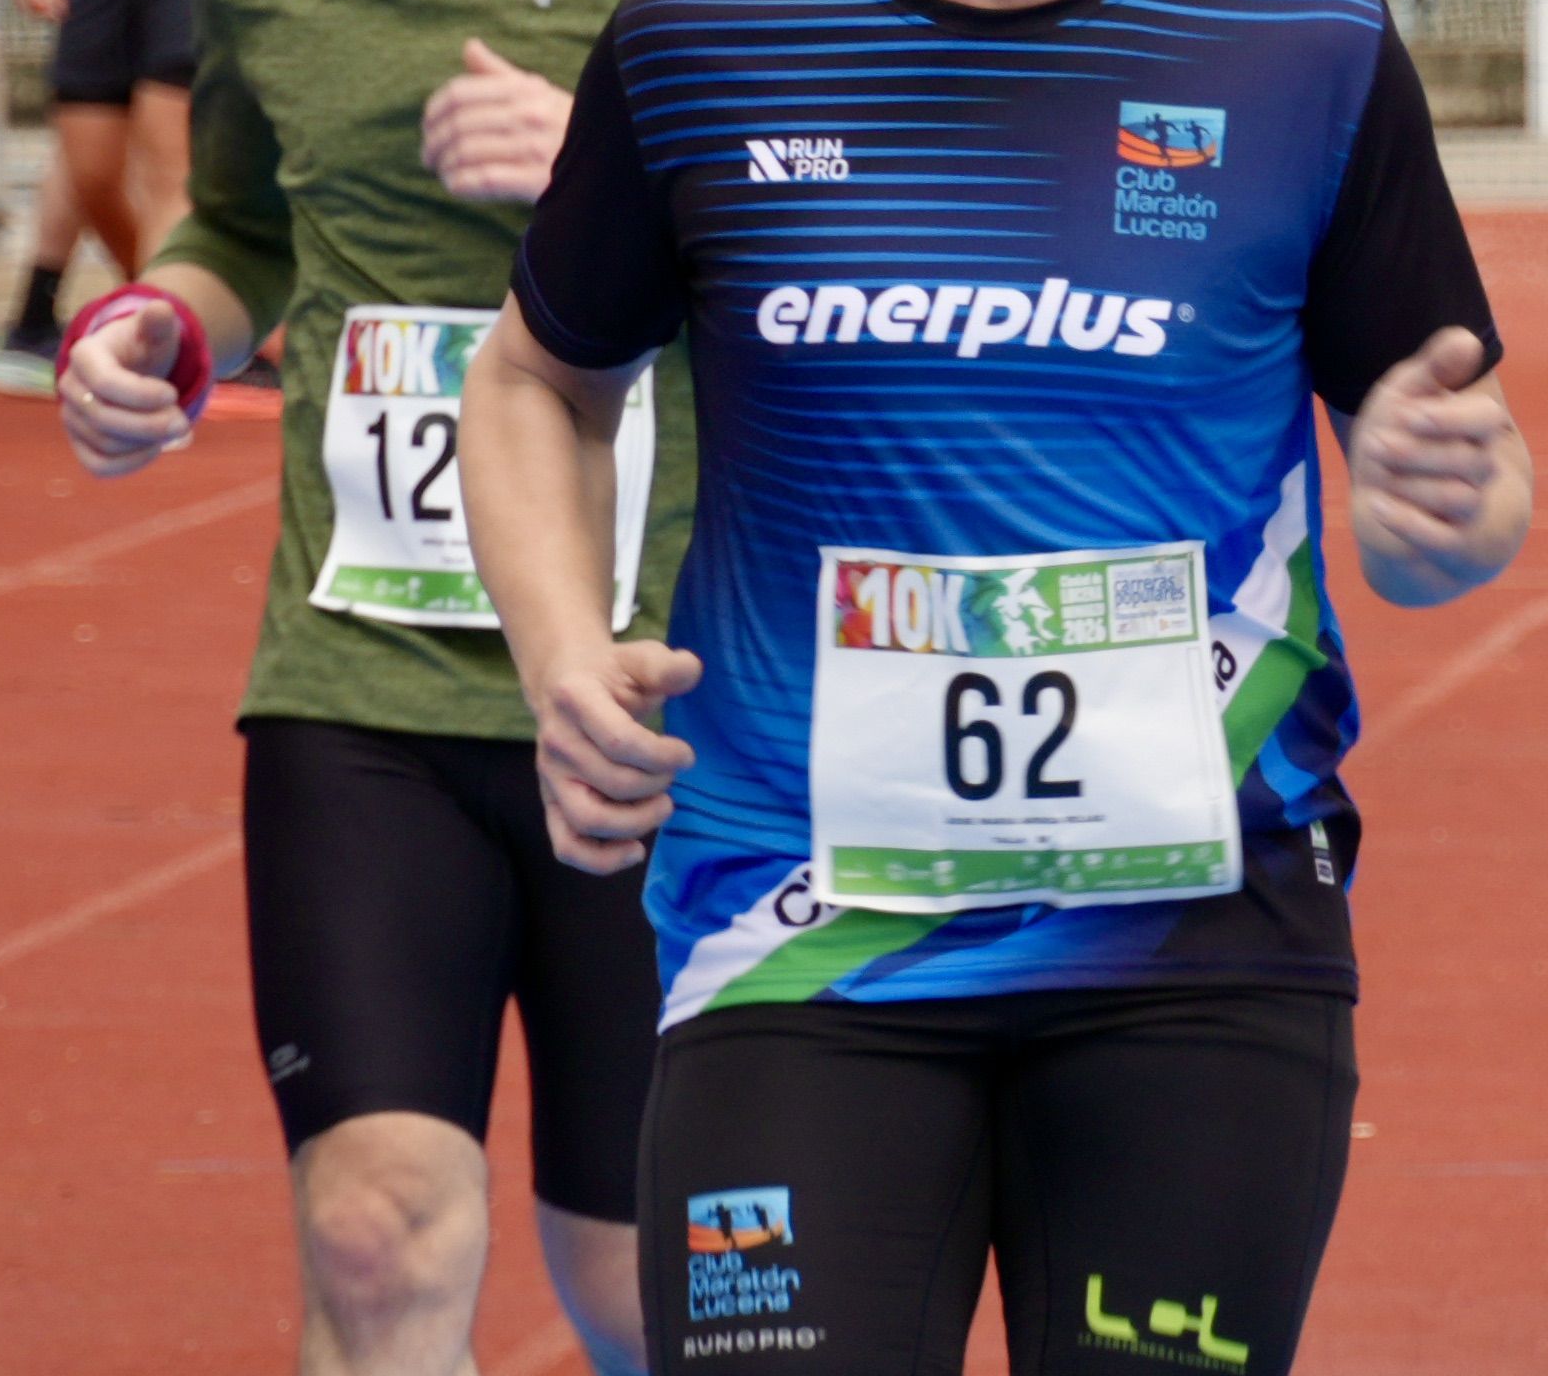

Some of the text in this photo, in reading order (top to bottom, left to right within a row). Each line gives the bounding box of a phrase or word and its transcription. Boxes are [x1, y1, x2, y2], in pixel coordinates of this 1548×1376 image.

[787, 137, 844, 160] RUN
[793, 158, 850, 182] PRO
[1116, 165, 1176, 192] Club
[1114, 188, 1218, 219] Maratón
[1113, 211, 1208, 241] Lucena
[356, 321, 441, 395] 10K
[367, 410, 458, 522] 12
[856, 565, 972, 654] 10K
[942, 669, 1084, 801] 62
[687, 1250, 744, 1274] Club
